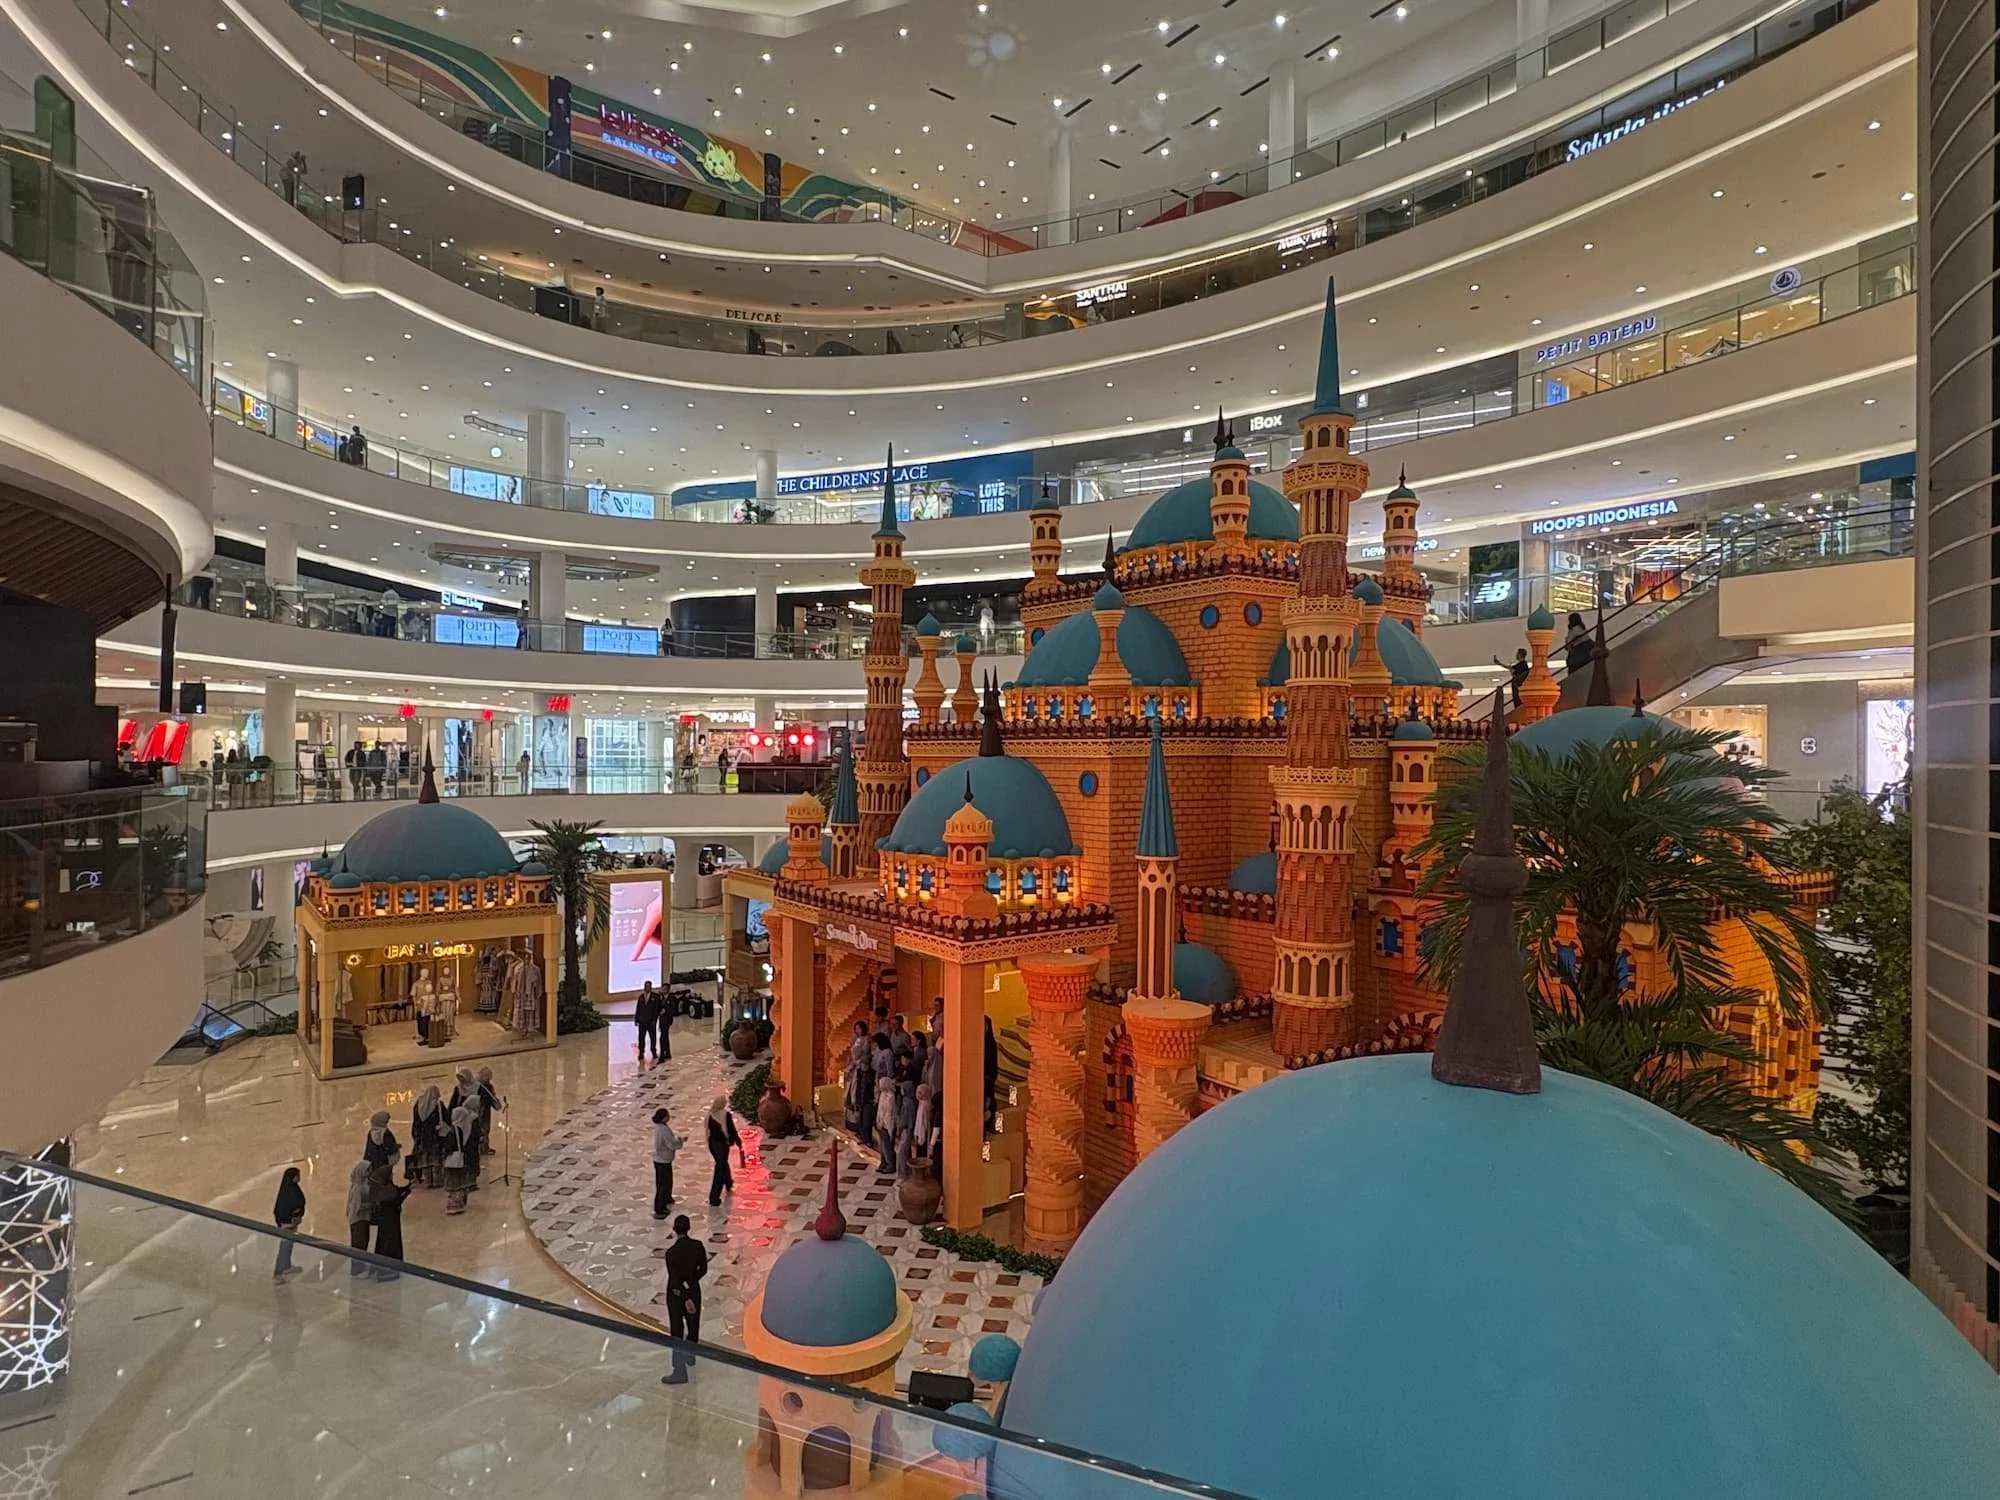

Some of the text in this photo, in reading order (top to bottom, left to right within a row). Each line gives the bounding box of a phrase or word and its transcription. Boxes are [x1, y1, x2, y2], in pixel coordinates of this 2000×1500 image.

[1537, 316, 1657, 363] PETIT BATEAU
[1249, 414, 1283, 432] iBox
[800, 470, 880, 491] CHILDREN'S
[980, 481, 1005, 498] LOVE
[980, 497, 1004, 513] THIS
[1532, 499, 1678, 535] HOOPS INDONESIA
